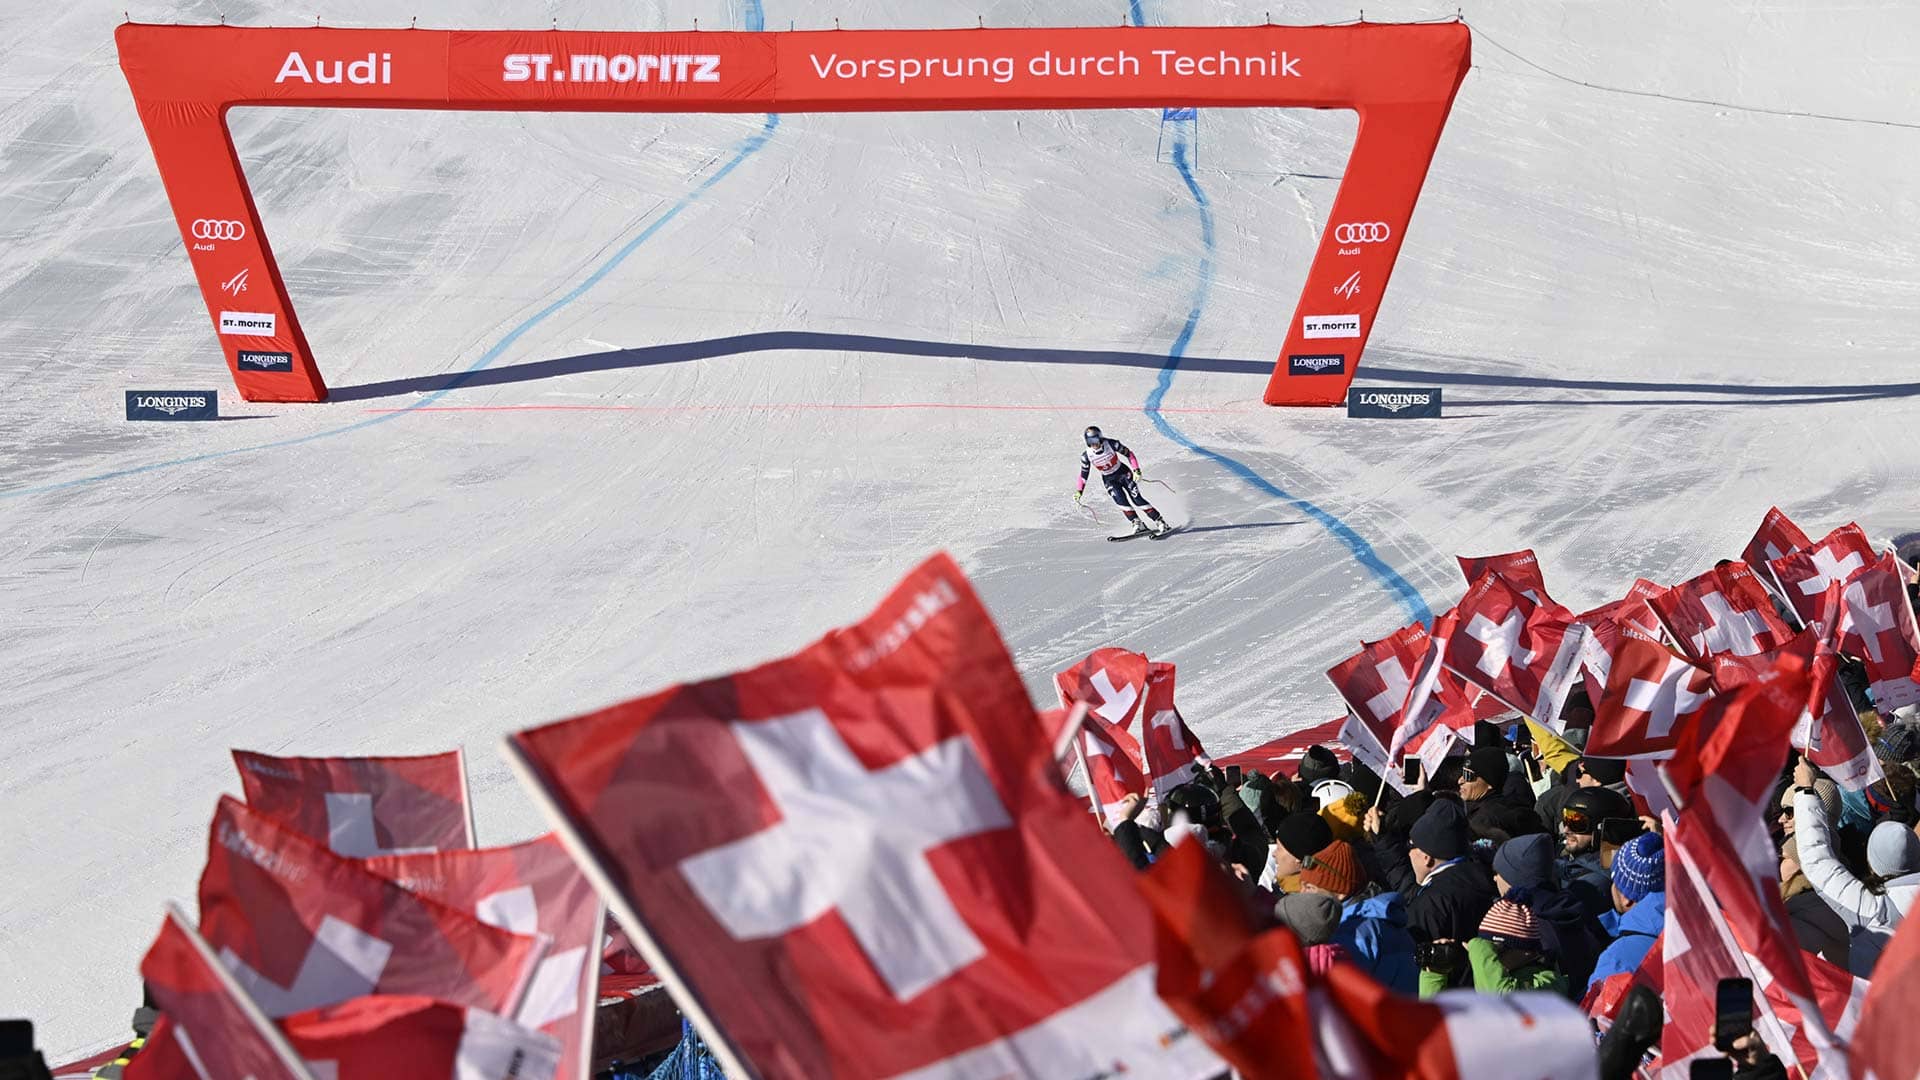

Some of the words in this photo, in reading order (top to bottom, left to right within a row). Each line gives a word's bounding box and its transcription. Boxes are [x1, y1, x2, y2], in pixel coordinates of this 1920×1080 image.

[275, 51, 391, 85] Audi
[809, 53, 1015, 84] Vorsprung
[1028, 50, 1139, 77] durch
[1151, 49, 1301, 78] Technik
[193, 243, 215, 251] Audi
[1338, 247, 1361, 256] Audi
[242, 354, 288, 364] LONGINES
[1293, 358, 1341, 367] LONGINES
[137, 396, 207, 408] LONGINES
[1359, 393, 1430, 405] LONGINES
